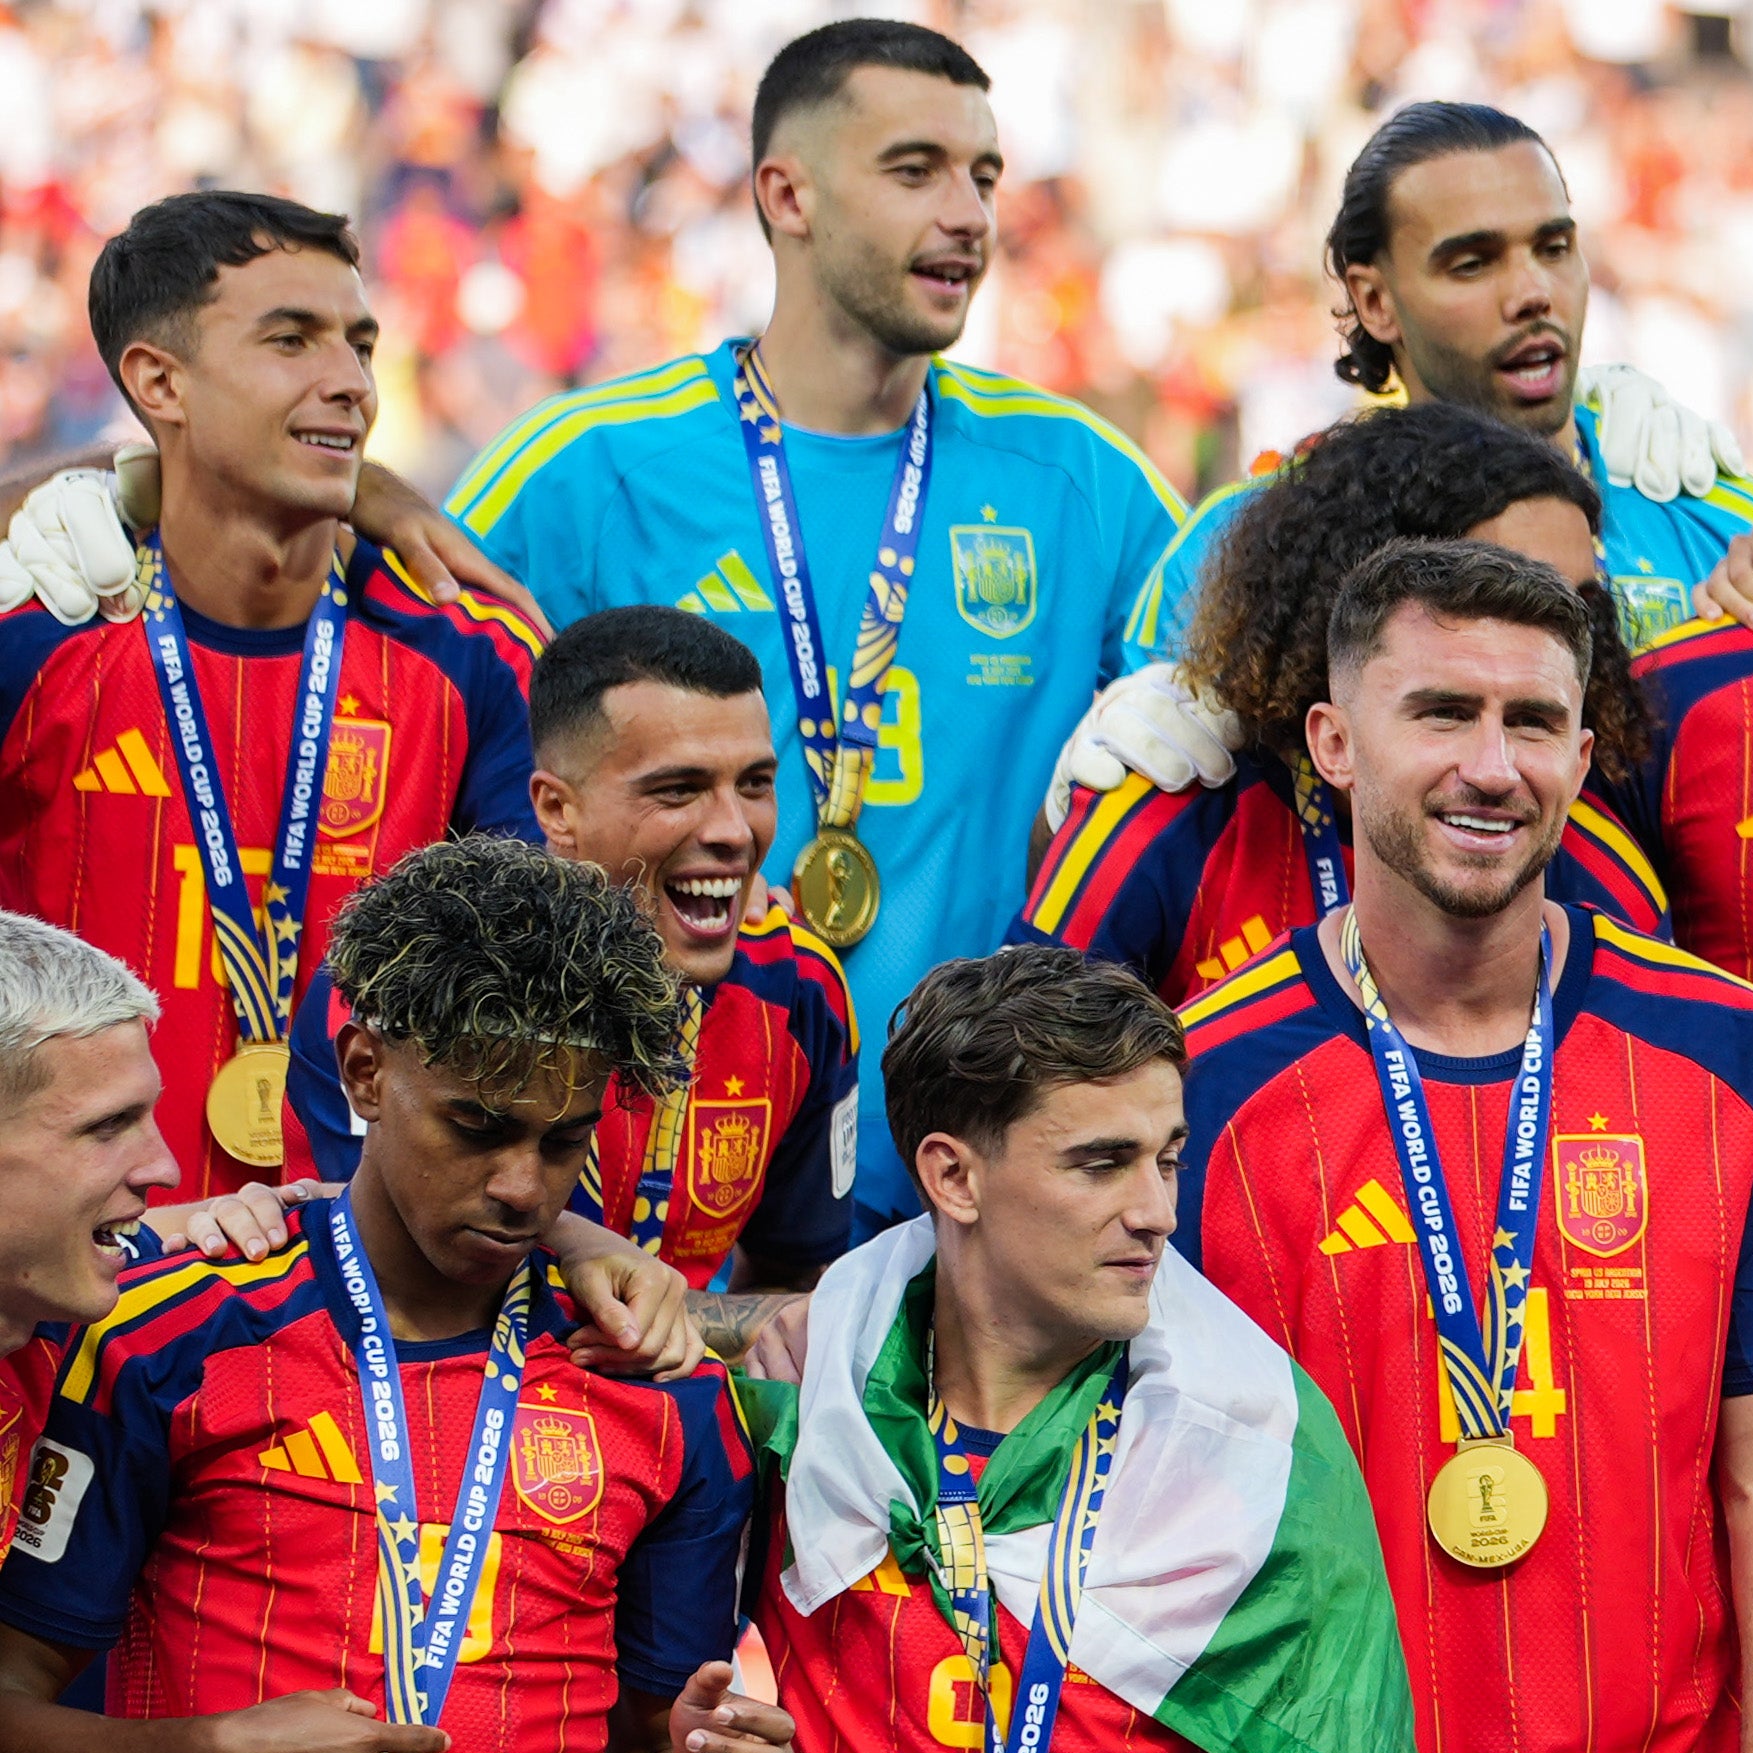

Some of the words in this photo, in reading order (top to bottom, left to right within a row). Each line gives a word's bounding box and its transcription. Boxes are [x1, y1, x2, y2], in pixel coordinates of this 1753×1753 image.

[910, 430, 927, 466] CUP
[758, 455, 782, 502] FIFA
[894, 463, 922, 534] 2026
[768, 501, 797, 577] WORLD
[783, 577, 806, 622] CUP
[158, 634, 184, 684] FIFA
[308, 619, 336, 694] 2026
[791, 622, 820, 699] 2026
[170, 683, 204, 763] WORLD
[301, 700, 325, 741] CUP
[190, 761, 214, 808] CUP
[288, 740, 318, 812] WORLD
[200, 810, 233, 888] 2026
[282, 813, 307, 870] FIFA
[1317, 858, 1339, 907] FIFA
[1384, 1050, 1410, 1100] FIFA
[1523, 1029, 1543, 1074] CUP
[1397, 1098, 1432, 1183] WORLD
[1514, 1075, 1541, 1160] WORLD
[1417, 1182, 1443, 1232] CUP
[1509, 1161, 1532, 1211] FIFA
[330, 1211, 355, 1260] FIFA
[1428, 1232, 1462, 1316] 2026
[362, 1333, 390, 1378] CUP
[372, 1377, 400, 1463] 2026
[474, 1408, 505, 1487] 2026
[462, 1485, 488, 1532] CUP
[14, 1528, 42, 1549] 2026
[1471, 1535, 1508, 1547] 2026
[439, 1532, 476, 1622] WORLD
[426, 1618, 456, 1670] FIFA
